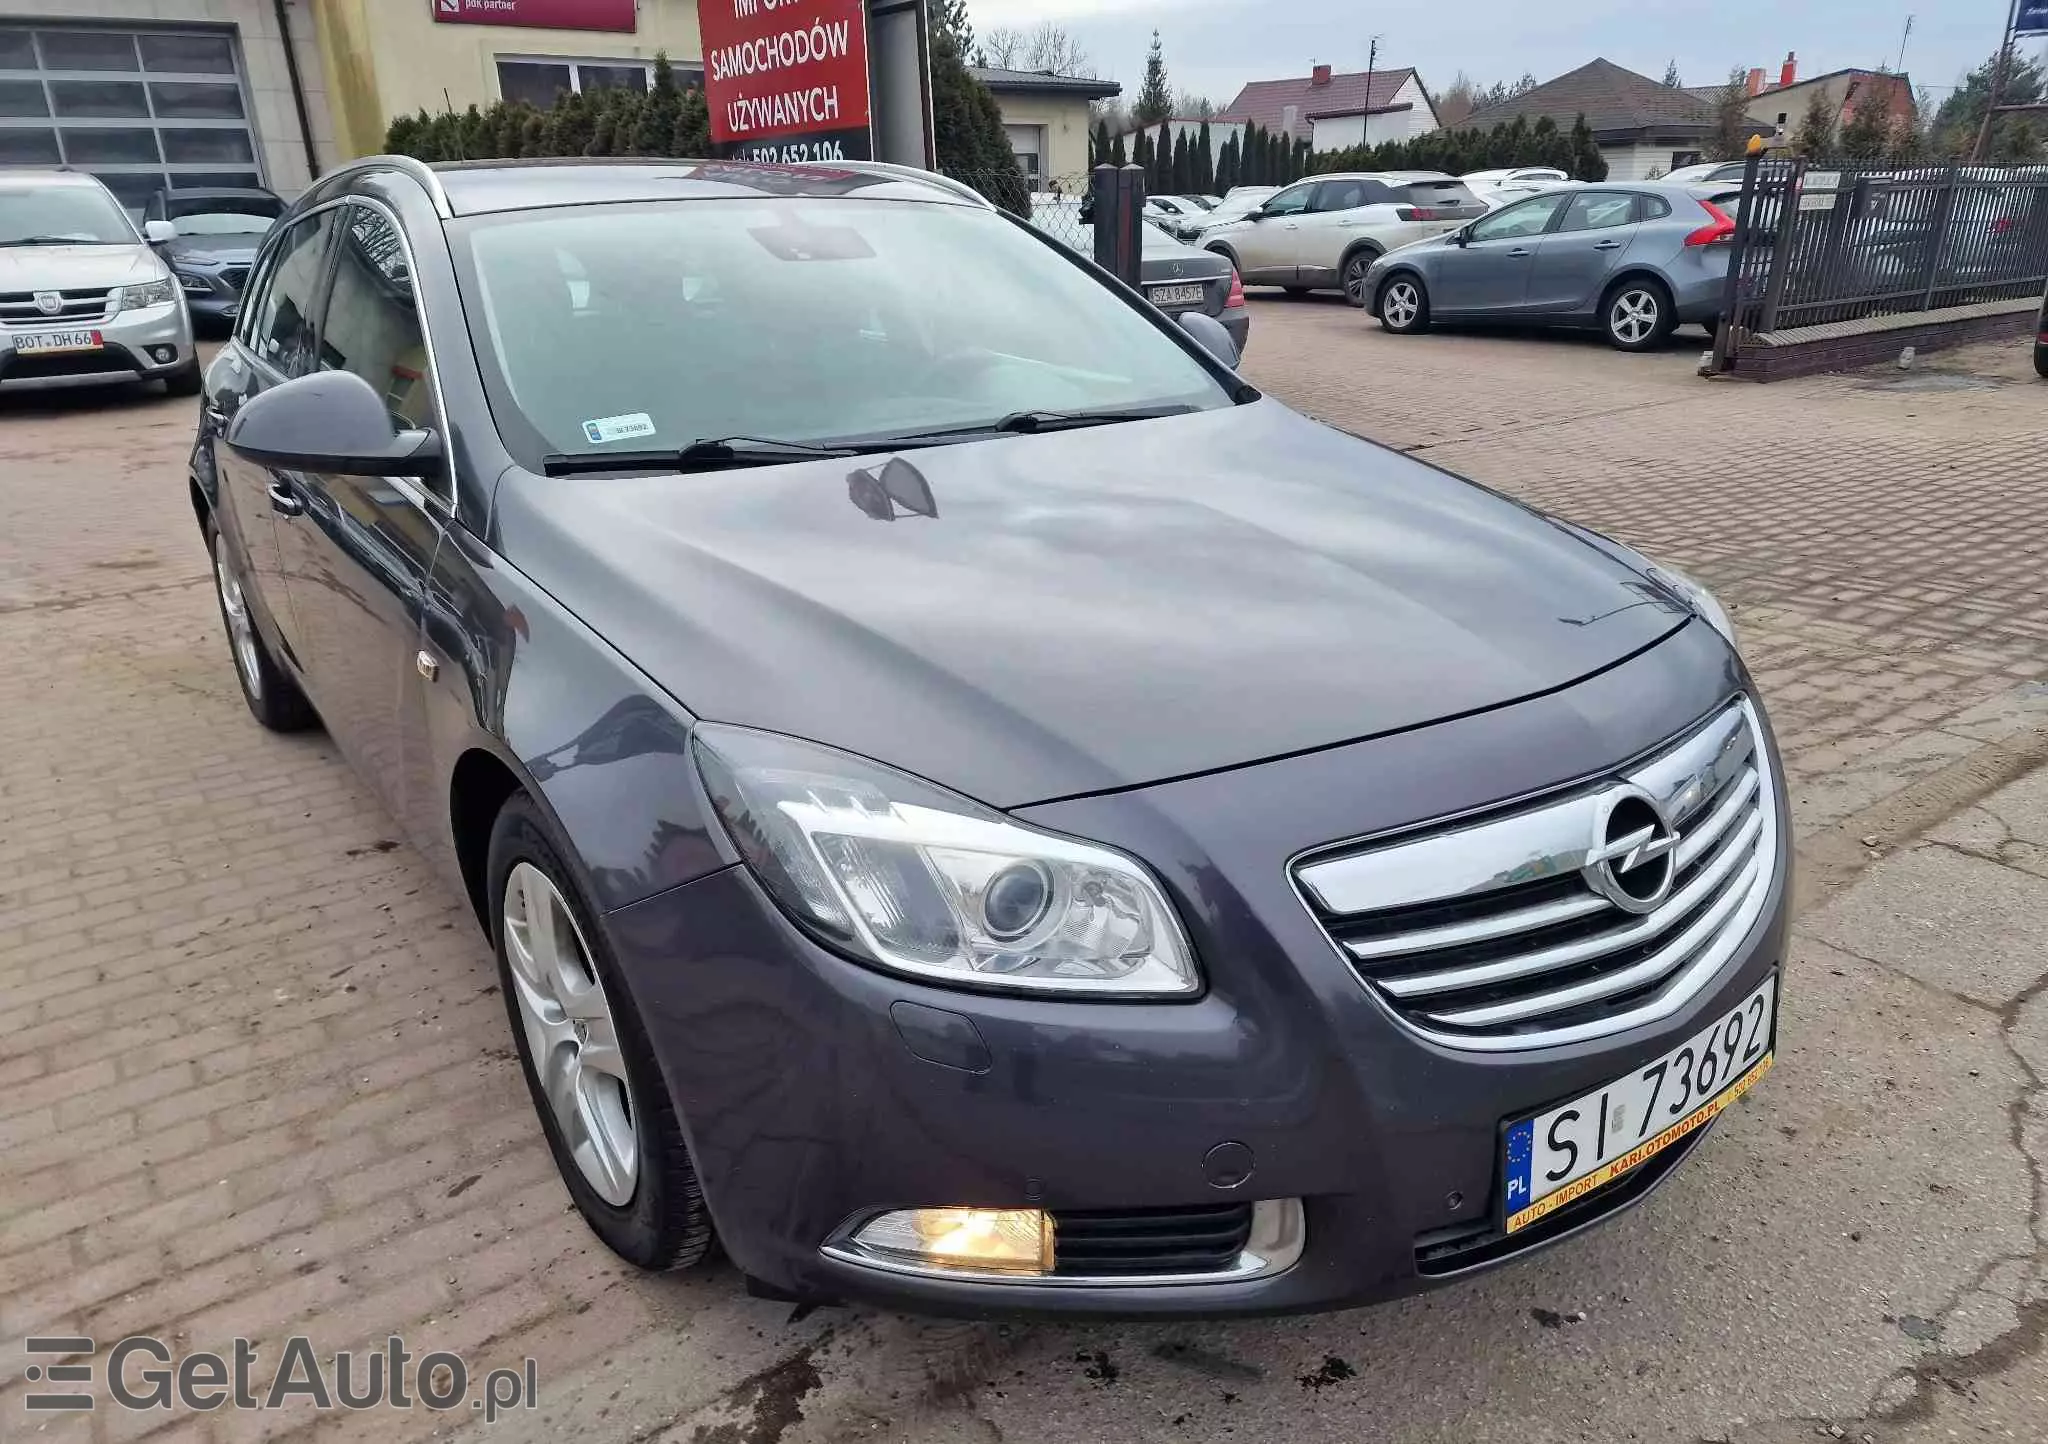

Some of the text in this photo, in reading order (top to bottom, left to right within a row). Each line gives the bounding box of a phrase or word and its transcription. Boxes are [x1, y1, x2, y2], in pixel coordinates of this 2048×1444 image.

[484, 0, 516, 10] partner
[711, 17, 848, 81] SAMOCHODÓW
[727, 85, 839, 132] UŻYWANYCH
[14, 335, 43, 349] BOT
[1546, 993, 1765, 1181] SI 73692
[1507, 1176, 1527, 1200] PL
[1514, 1202, 1546, 1228] AUTO
[1555, 1175, 1599, 1206] IMPORT
